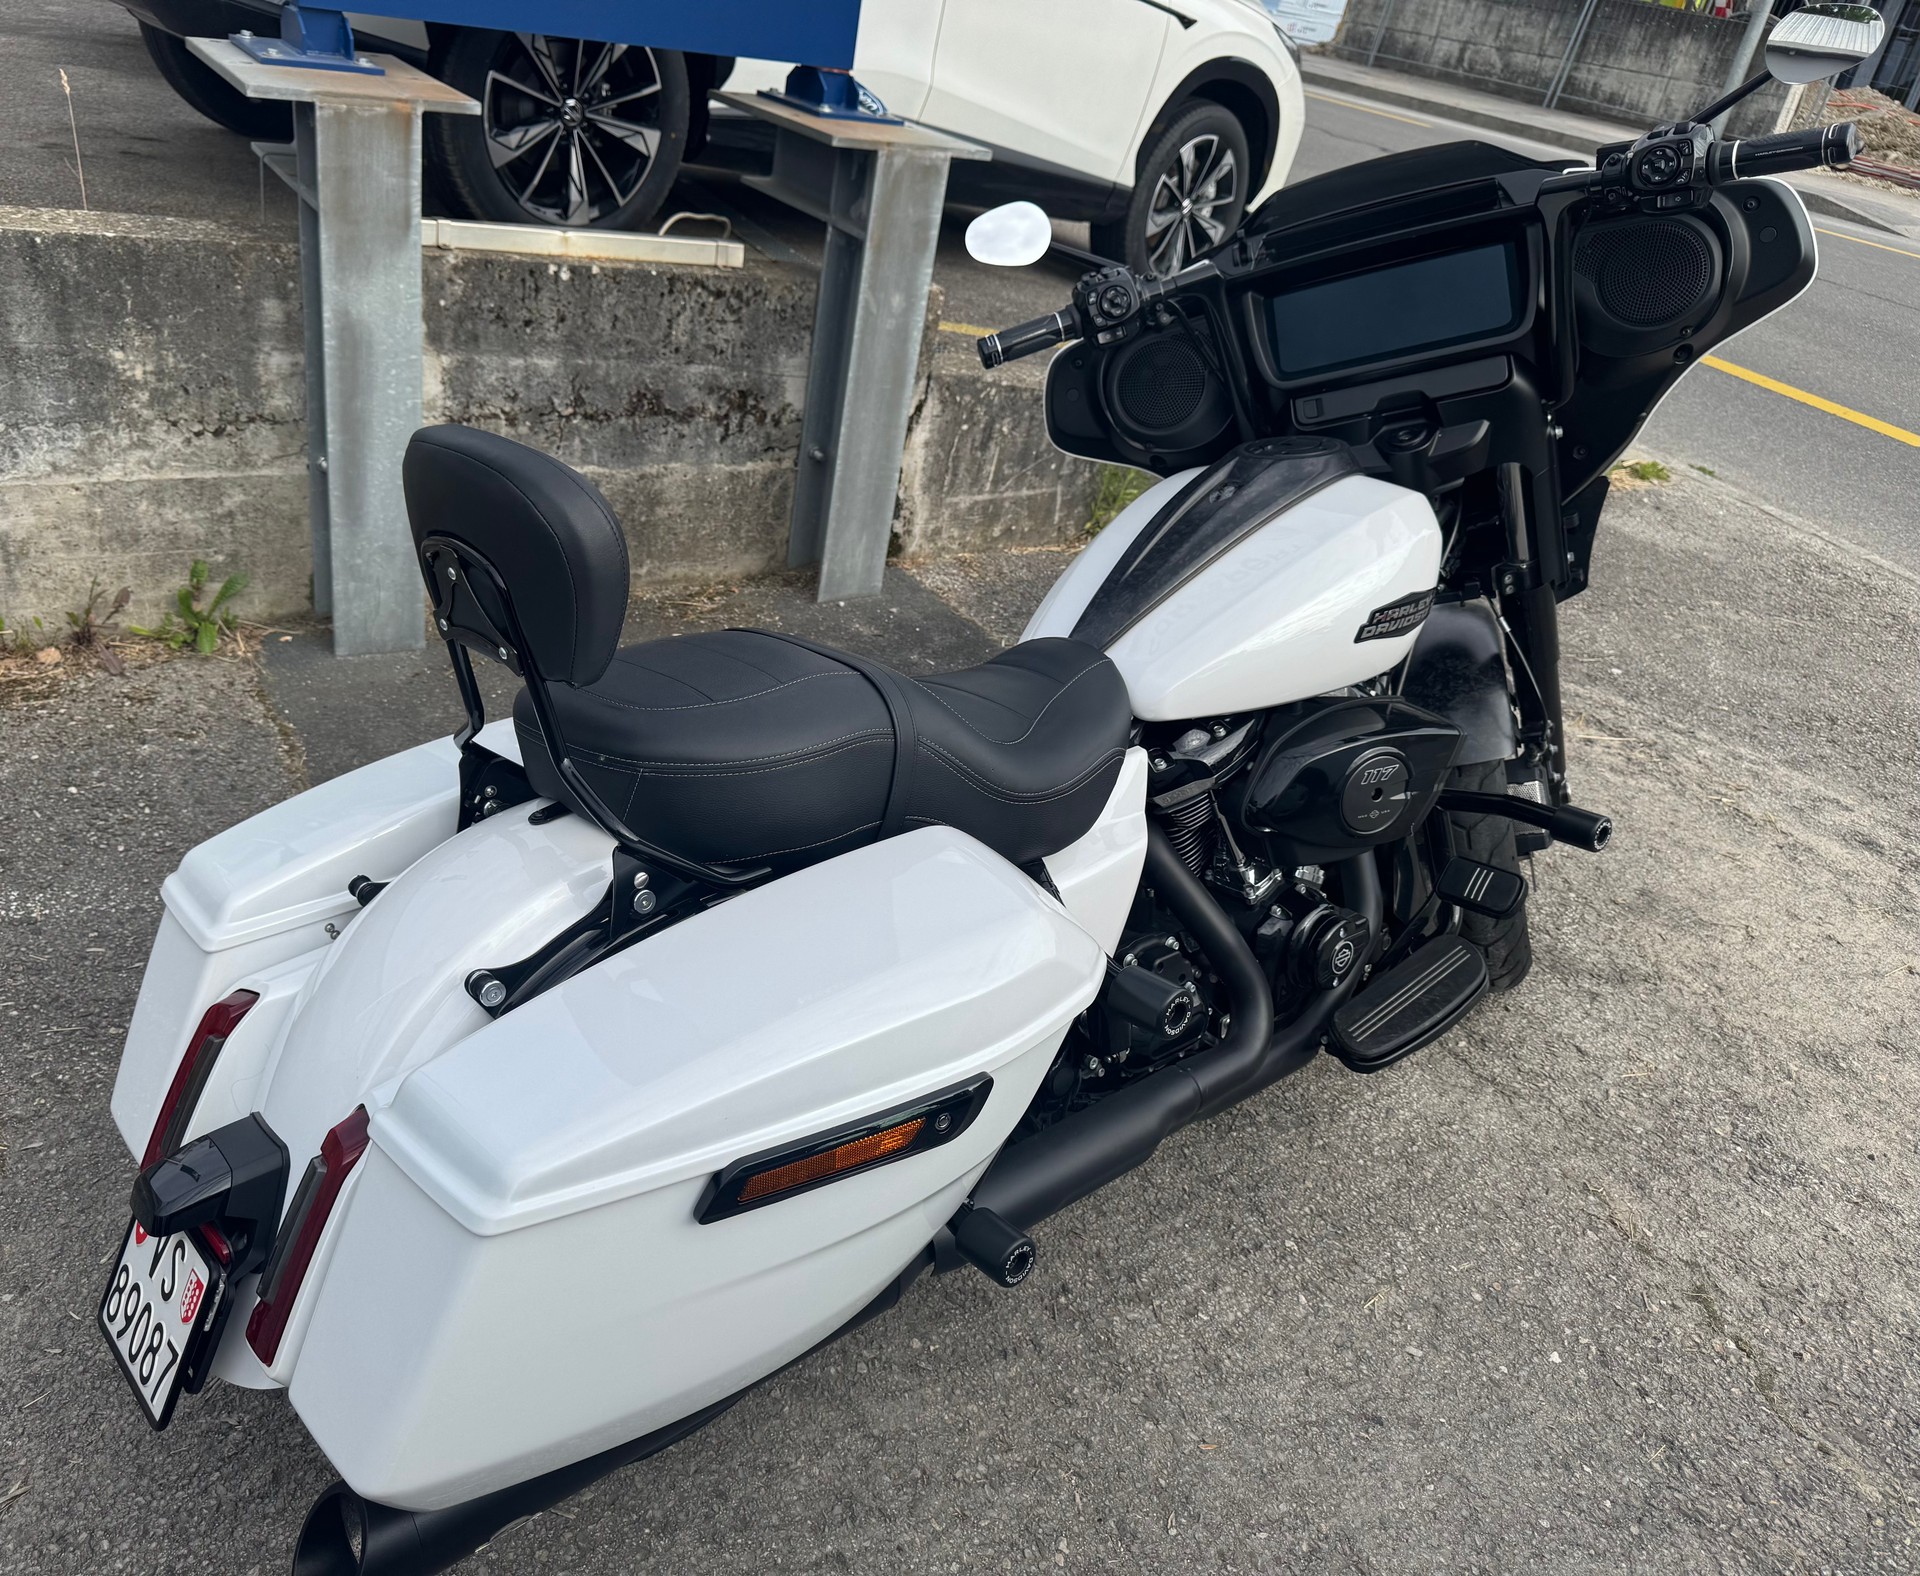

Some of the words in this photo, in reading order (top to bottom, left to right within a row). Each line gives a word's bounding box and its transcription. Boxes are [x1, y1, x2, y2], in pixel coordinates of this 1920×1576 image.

[1373, 595, 1433, 624] HARLEY
[1361, 764, 1399, 785] 117
[149, 1235, 186, 1302] VS
[107, 1264, 179, 1404] 89087
